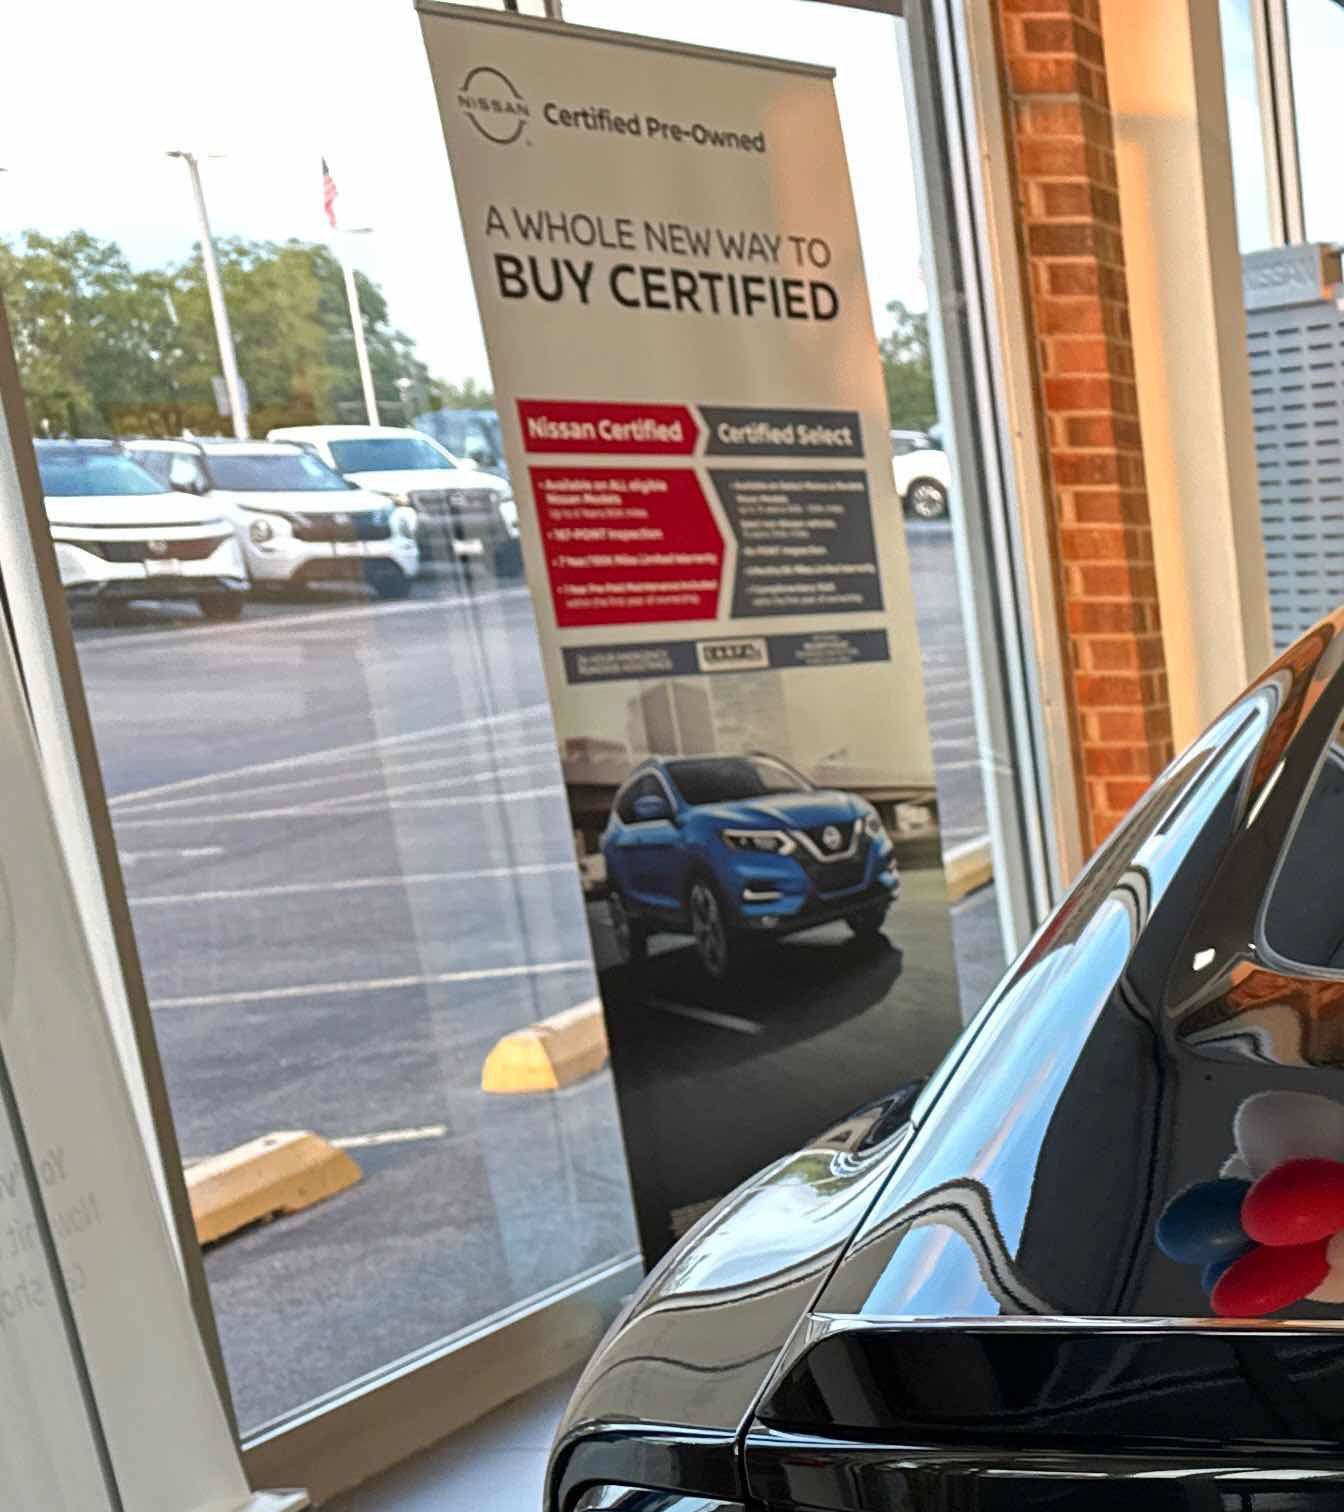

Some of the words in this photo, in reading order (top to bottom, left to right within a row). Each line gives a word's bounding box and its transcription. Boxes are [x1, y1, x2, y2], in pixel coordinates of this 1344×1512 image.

[457, 94, 531, 117] NISSAN
[543, 102, 643, 137] Certified
[645, 116, 767, 153] Pre-Owned
[485, 205, 509, 240] A
[513, 207, 633, 251] WHOLE
[644, 220, 713, 259] NEW
[716, 229, 782, 264] WAY
[788, 235, 831, 269] TO
[494, 254, 594, 305] BUY
[610, 263, 839, 322] CERTIFIED
[527, 416, 596, 440] Nissan
[599, 418, 684, 443] Certified
[717, 421, 795, 445] Certified
[797, 422, 853, 446] Select
